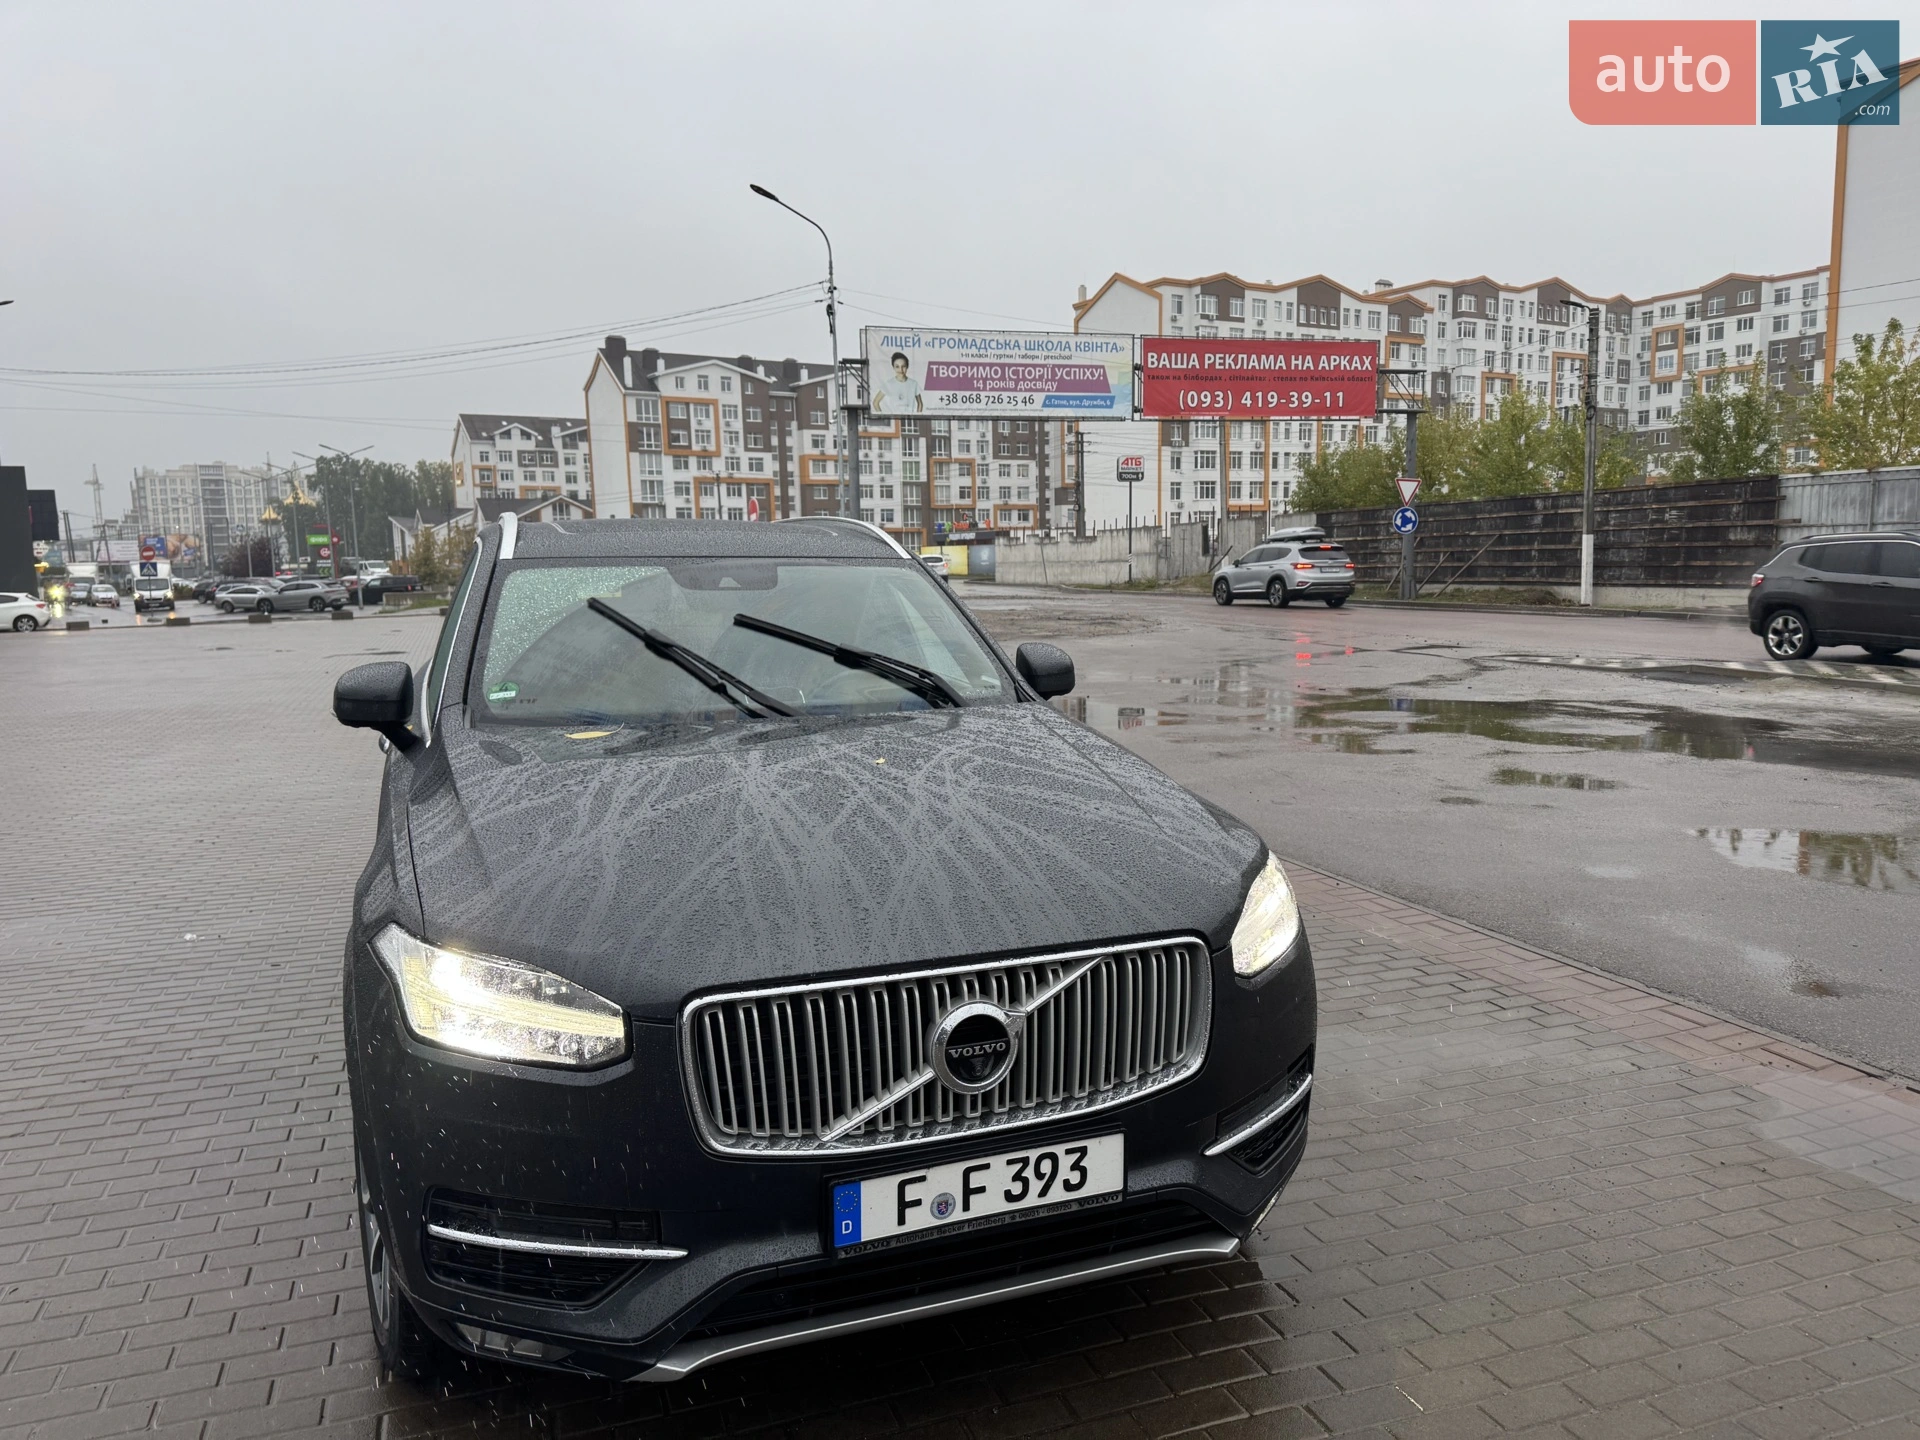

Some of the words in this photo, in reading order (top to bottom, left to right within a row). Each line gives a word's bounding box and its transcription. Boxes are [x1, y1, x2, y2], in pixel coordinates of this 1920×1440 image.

[880, 334, 921, 350] ЛІЦЕЙ
[925, 337, 1021, 352] «ГРОМАДСЬКА
[1024, 338, 1072, 352] ШКОЛА
[1075, 340, 1125, 353] КВІНТА»
[1018, 352, 1040, 361] табори
[1043, 353, 1073, 361] preschool
[1146, 351, 1200, 369] ВАША
[1204, 353, 1287, 370] РЕКЛАМА
[1291, 354, 1315, 371] НА
[1318, 355, 1373, 371] АРКАХ
[930, 364, 1001, 379] ТВОРИМО
[1005, 364, 1053, 381] ІСТОРІЇ
[1054, 366, 1104, 381] УСПІХУ!
[1183, 373, 1223, 382] білбордах
[1347, 375, 1373, 383] області
[973, 380, 984, 390] 14
[986, 378, 1016, 391] років
[1018, 379, 1058, 392] досвіду
[938, 393, 959, 406] +38
[961, 392, 982, 405] 068
[984, 394, 1004, 407] 726
[1006, 395, 1019, 407] 25
[1020, 394, 1035, 407] 46
[1178, 389, 1234, 410] (093)
[1240, 390, 1345, 408] 419-39-11
[1121, 457, 1142, 466] АТБ
[948, 1042, 1006, 1058] VOLVO
[896, 1174, 927, 1227] F
[962, 1162, 991, 1212] F
[1003, 1145, 1088, 1203] 393
[841, 1220, 853, 1235] D
[843, 1238, 892, 1256] VOLVO
[895, 1231, 935, 1246] Autohaus
[936, 1223, 966, 1236] Becker
[967, 1216, 1007, 1231] Friedberg
[1075, 1194, 1119, 1208] VOLVO
